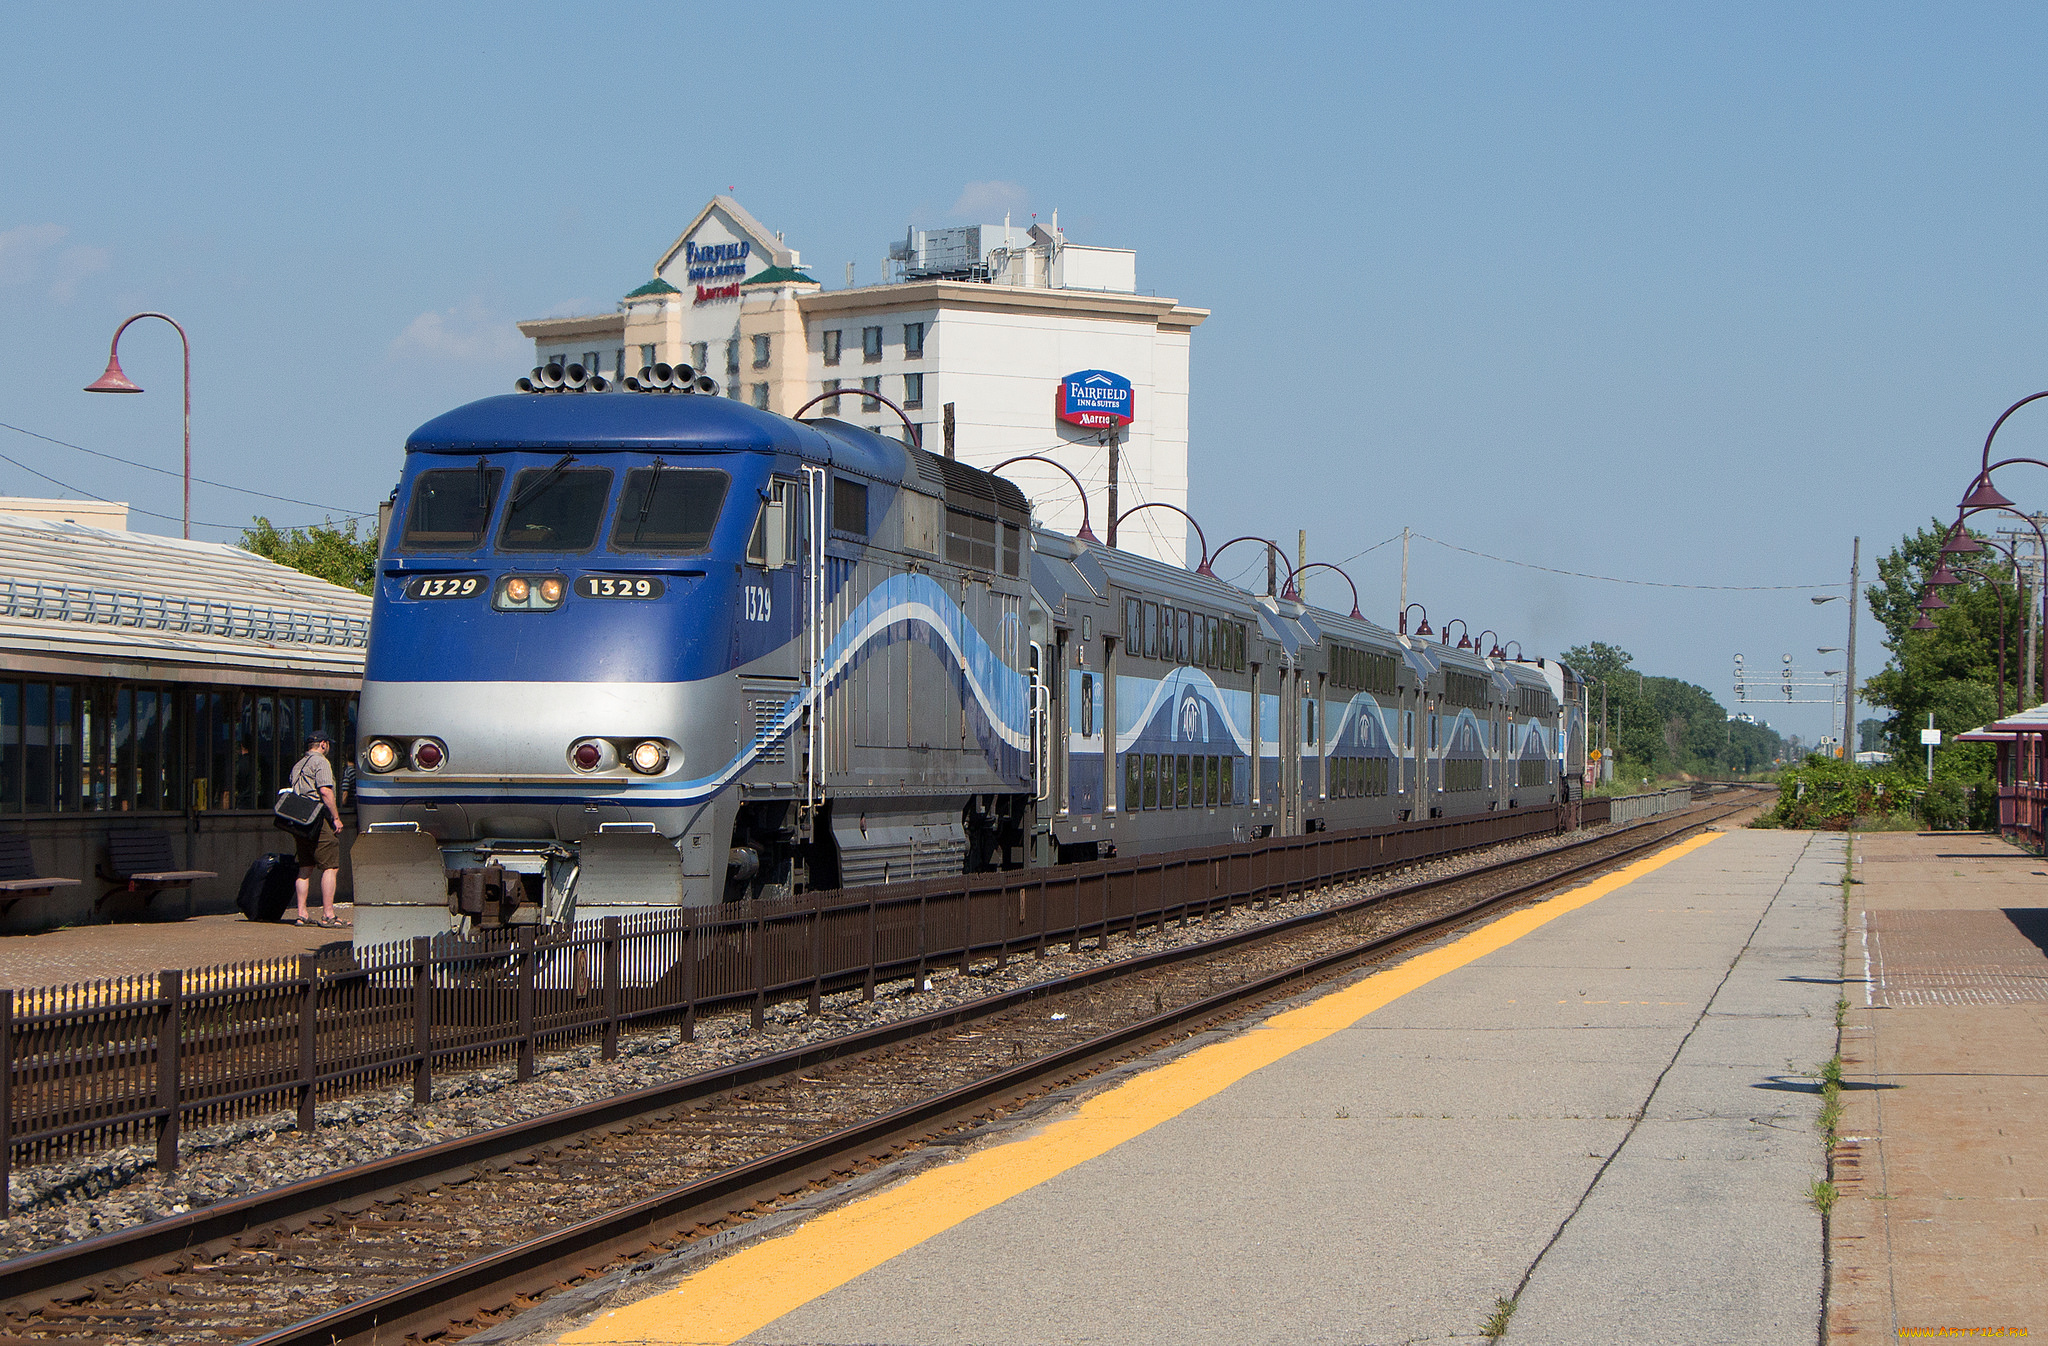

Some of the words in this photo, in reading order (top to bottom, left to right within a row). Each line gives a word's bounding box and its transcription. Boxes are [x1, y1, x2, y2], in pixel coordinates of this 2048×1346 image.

[1071, 382, 1127, 400] FAIRFIELD
[1079, 413, 1110, 425] Marrio
[419, 578, 478, 596] 1329
[589, 579, 651, 596] 1329
[745, 585, 771, 622] 1329
